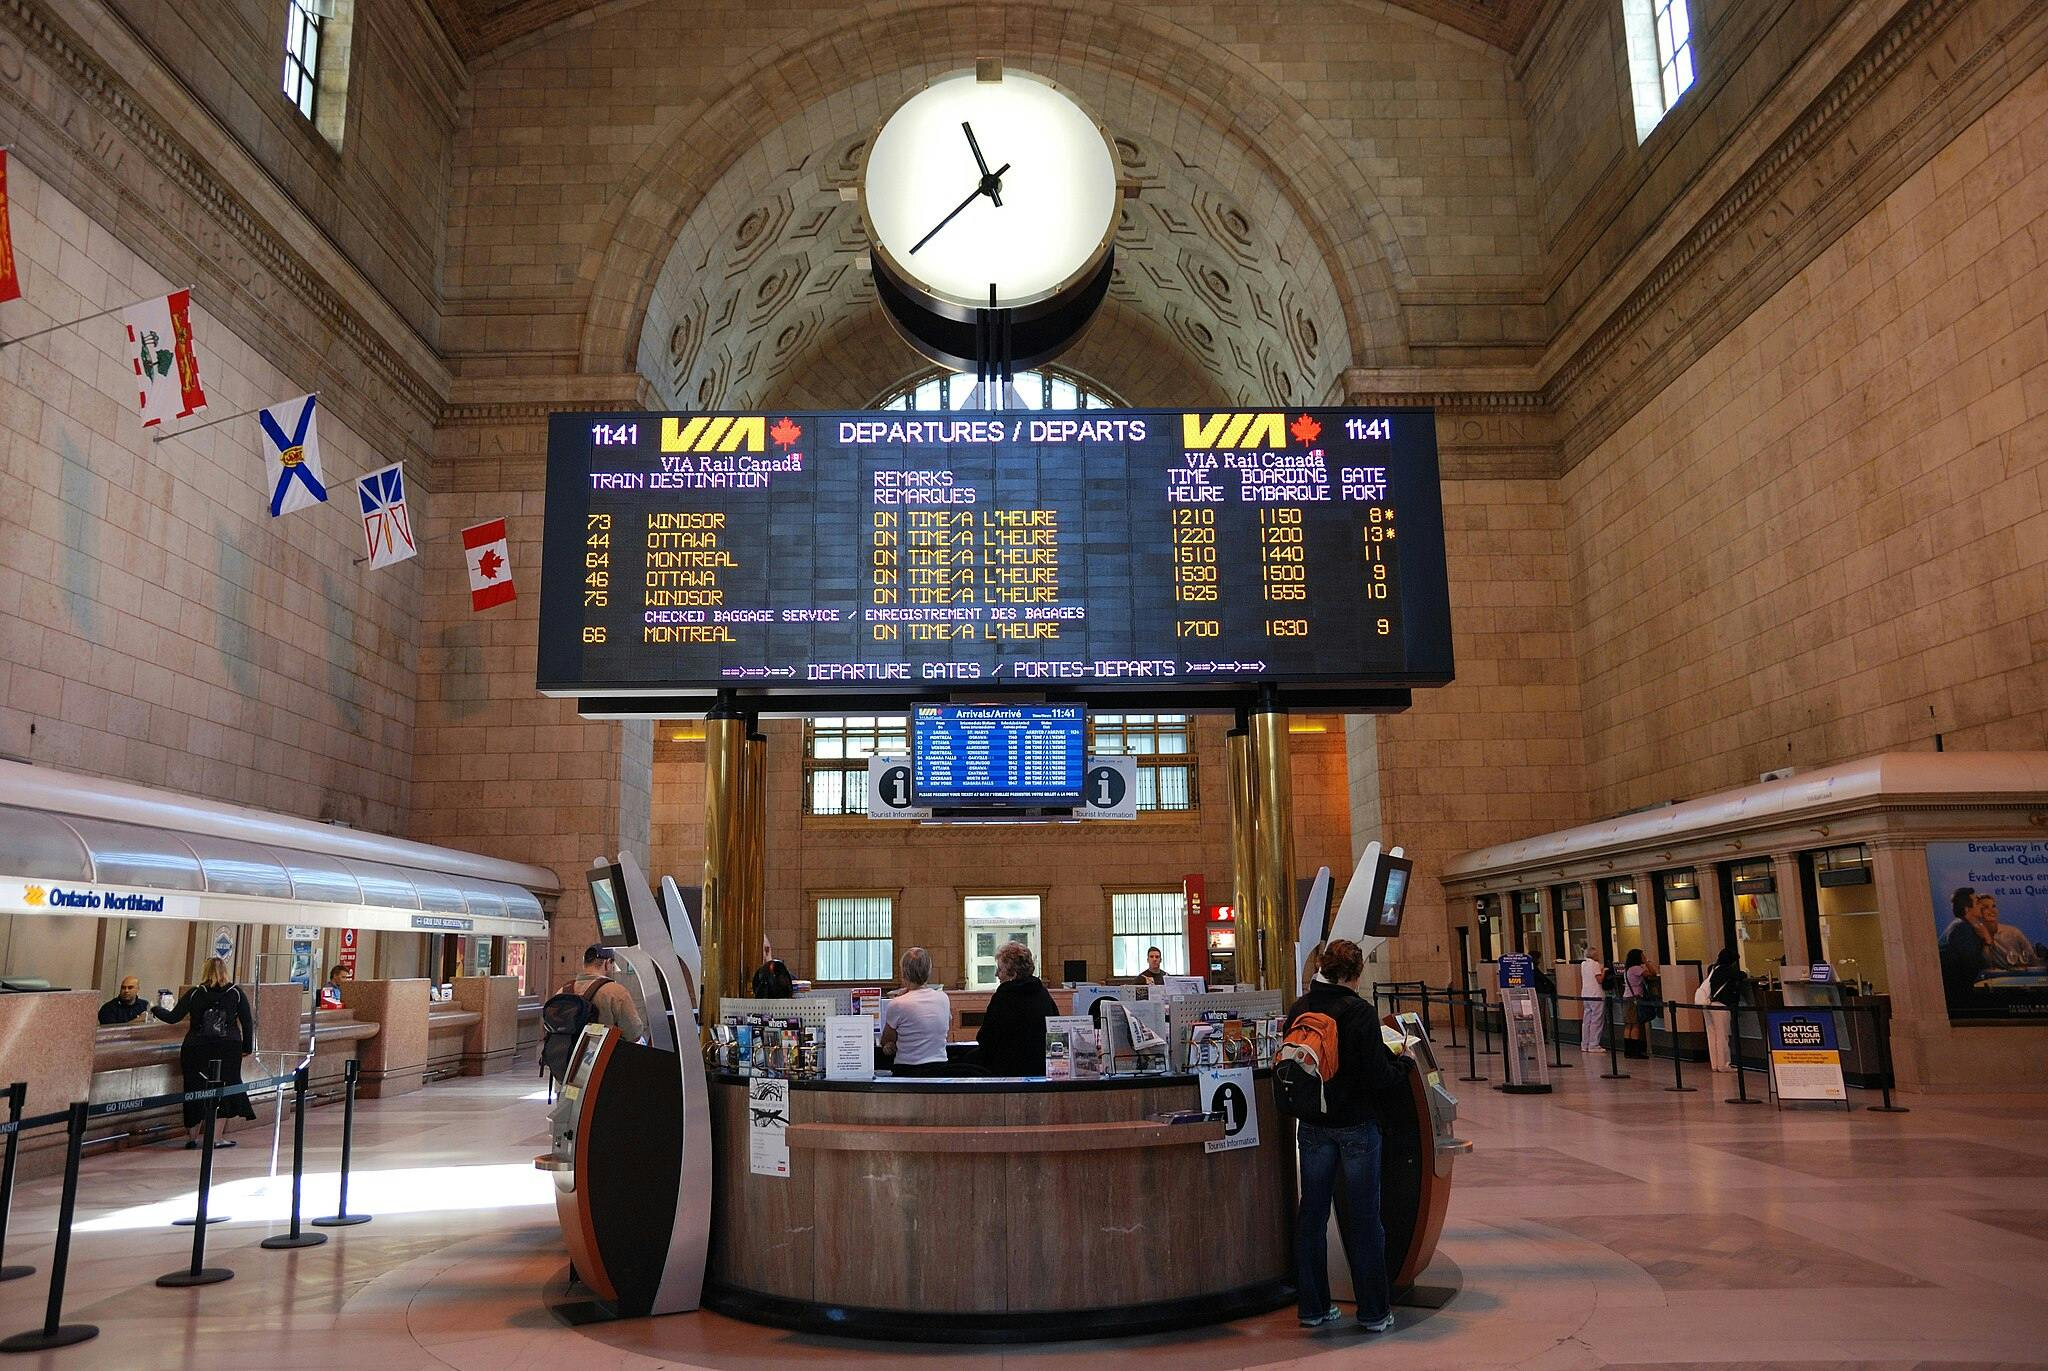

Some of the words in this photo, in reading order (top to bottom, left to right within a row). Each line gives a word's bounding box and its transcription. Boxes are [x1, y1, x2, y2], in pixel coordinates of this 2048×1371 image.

[592, 424, 636, 445] 11:41
[661, 417, 765, 452] VIA
[840, 422, 1011, 443] DEPARTURES
[1012, 421, 1022, 441] /
[1030, 421, 1145, 441] DEPARTS
[1183, 414, 1286, 448] VIA
[1345, 419, 1390, 439] 11:41
[661, 457, 694, 472] VIA
[699, 456, 734, 472] Rail
[739, 455, 802, 471] Canada
[1185, 453, 1218, 467] VIA
[1224, 453, 1258, 467] Rail
[1262, 451, 1325, 467] Canada
[590, 473, 643, 489] TRAIN
[650, 473, 768, 488] DESTINATION
[874, 471, 953, 486] REMARKS
[1167, 469, 1209, 484] TIME
[1241, 469, 1327, 484] BOARDING
[1342, 468, 1386, 483] GATE
[874, 488, 975, 504] REMARQUES
[1168, 486, 1224, 502] HEURE
[1242, 485, 1330, 501] EMBARQUE
[1342, 485, 1386, 500] PORT
[588, 515, 611, 529] 73
[649, 513, 725, 529] WINDSOR
[874, 512, 897, 527] ON
[908, 511, 973, 527] TIME/A
[984, 511, 1057, 526] L'HEURE
[1173, 509, 1214, 524] 1210
[1261, 509, 1301, 524] 1150
[587, 534, 609, 548] 44
[648, 532, 716, 548] OTTAWA
[874, 531, 897, 546] ON
[908, 530, 973, 546] TIME/A
[984, 530, 1057, 545] L'HEURE
[1174, 528, 1214, 543] 1220
[1262, 527, 1302, 543] 1200
[586, 552, 609, 567] 64
[647, 551, 738, 567] MONTREAL
[874, 550, 897, 565] ON
[908, 550, 973, 565] TIME/A
[985, 549, 1058, 565] L'HEURE
[1175, 547, 1215, 562] 1510
[1263, 546, 1303, 561] 1440
[1366, 546, 1380, 560] 11
[586, 572, 608, 587] 46
[647, 571, 715, 586] OTTAWA
[874, 569, 897, 585] ON
[908, 569, 973, 584] TIME/A
[985, 568, 1058, 583] L'HEURE
[1175, 567, 1216, 581] 1530
[1264, 566, 1304, 580] 1500
[1374, 565, 1385, 579] 9
[585, 591, 607, 606] 75
[646, 590, 722, 605] WINDSOR
[874, 588, 897, 604] ON
[908, 588, 973, 604] TIME/A
[985, 587, 1058, 602] L'HEURE
[1176, 586, 1217, 600] 1625
[1265, 584, 1305, 600] 1555
[1368, 584, 1386, 598] 10
[645, 611, 705, 623] CHECKED
[714, 610, 774, 622] BAGGAGE
[783, 609, 839, 621] SERVICE
[866, 608, 982, 620] ENREGISTREMENT
[991, 608, 1016, 619] DES
[1025, 607, 1084, 619] BAGAGES
[583, 627, 606, 642] 66
[645, 626, 736, 642] MONTREAL
[874, 624, 897, 640] ON
[908, 623, 974, 639] TIME/A
[985, 623, 1059, 639] L'HEURE
[1178, 621, 1219, 636] 1700
[1266, 620, 1308, 636] 1630
[1377, 619, 1389, 634] 9
[807, 663, 911, 680] DEPARTURE
[923, 663, 980, 678] GATES
[1014, 661, 1175, 677] PORTES-DEPARTS
[956, 709, 1022, 718] Arrivals/Arrivé
[1052, 709, 1075, 718] 11:41
[1968, 843, 2027, 854] Breakaway
[2031, 843, 2040, 851] in
[1995, 855, 2014, 864] and
[1968, 870, 2033, 882] Évadez-vous
[50, 887, 101, 908] Ontario
[104, 892, 164, 912] Northland
[1209, 1010, 1227, 1019] where
[769, 1019, 787, 1028] where
[256, 1079, 272, 1087] TRANSIT
[185, 1092, 194, 1100] GO
[195, 1089, 216, 1098] TRANSIT
[106, 1104, 116, 1112] GO
[117, 1100, 144, 1110] TRANSIT
[0, 1120, 19, 1133] NSIT
[1208, 1142, 1226, 1150] Tourist
[1227, 1137, 1256, 1148] Information
